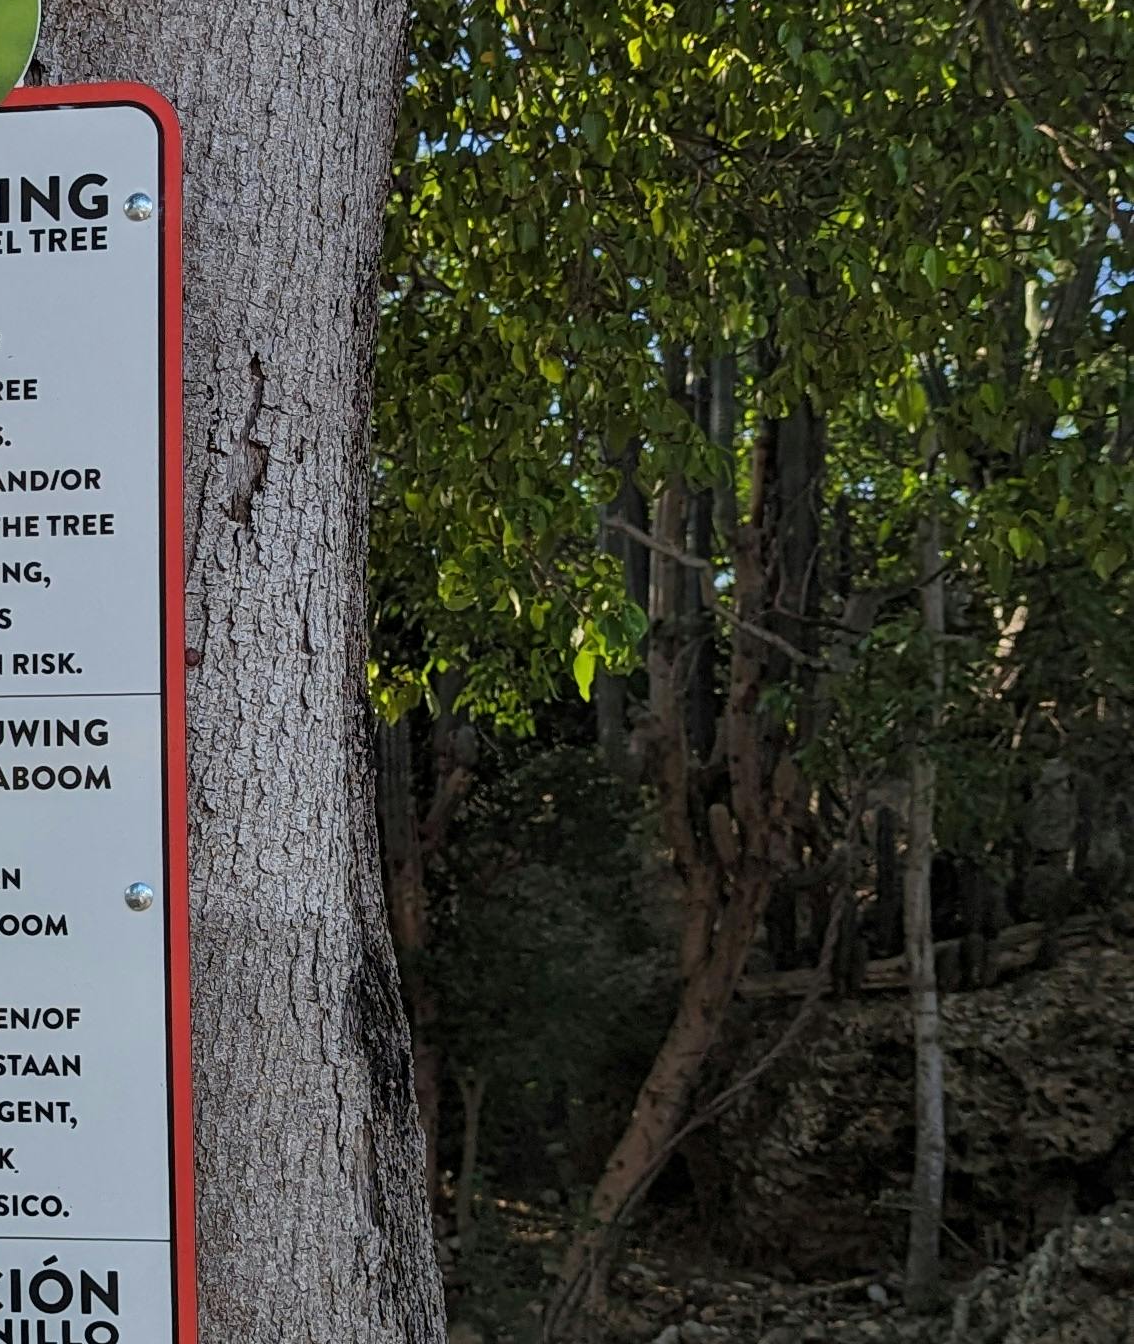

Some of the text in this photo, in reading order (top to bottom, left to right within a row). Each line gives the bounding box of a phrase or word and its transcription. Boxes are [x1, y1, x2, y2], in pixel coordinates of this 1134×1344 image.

[28, 225, 108, 253] TREE
[46, 513, 115, 537] TREE
[12, 652, 83, 675] RISK.
